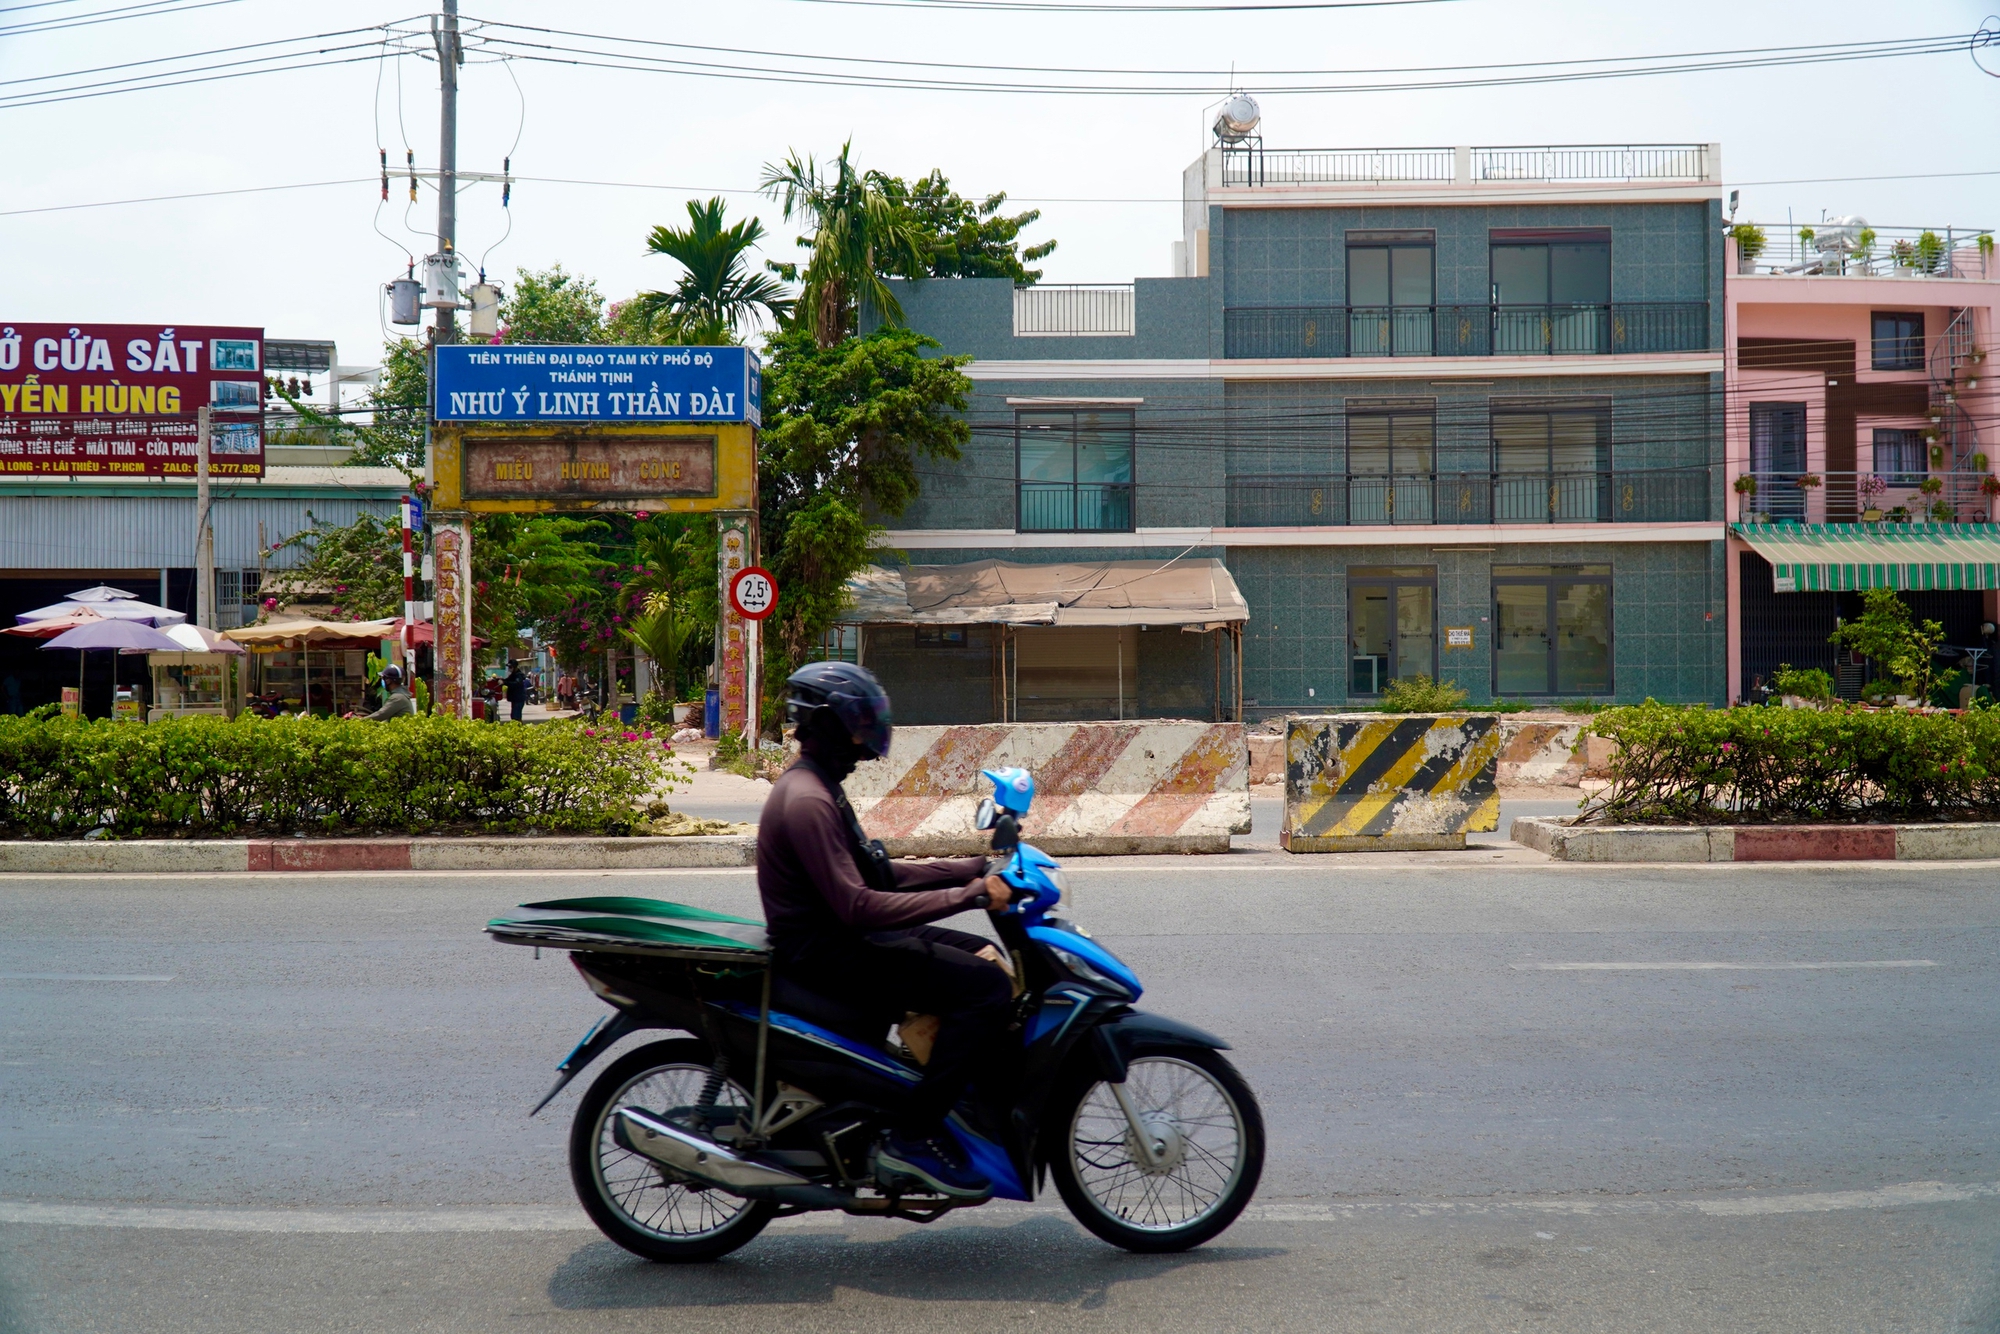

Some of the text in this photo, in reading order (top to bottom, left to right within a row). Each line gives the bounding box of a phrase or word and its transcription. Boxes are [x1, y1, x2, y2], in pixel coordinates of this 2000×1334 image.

[34, 327, 115, 372] CỬA
[126, 328, 203, 372] SẮT
[468, 349, 713, 368] TIÊN THIÊN ĐẠI ĐẠO TAM KỲ PHỔ ĐỘ
[549, 370, 633, 386] THÁNH TỊNH
[81, 379, 180, 414] HÙNG
[450, 387, 505, 415] NHƯ
[512, 385, 530, 415] Ý
[538, 392, 600, 415] LINH
[608, 381, 681, 416] THẦN
[689, 386, 735, 416] ĐÀI
[30, 420, 61, 434] INOX
[73, 418, 112, 435] NHÔM
[54, 436, 76, 455] CHẾ
[86, 438, 108, 455] MÁI
[111, 438, 136, 456] THÁI
[146, 437, 169, 456] CỬA
[7, 461, 33, 471] LONG
[71, 460, 99, 472] THIÊU
[109, 462, 145, 472] TP.HCM
[163, 463, 191, 472] ZALO:
[194, 463, 260, 474] 045.777.929
[496, 456, 681, 480] MIẾU HUỲNH CÔNG
